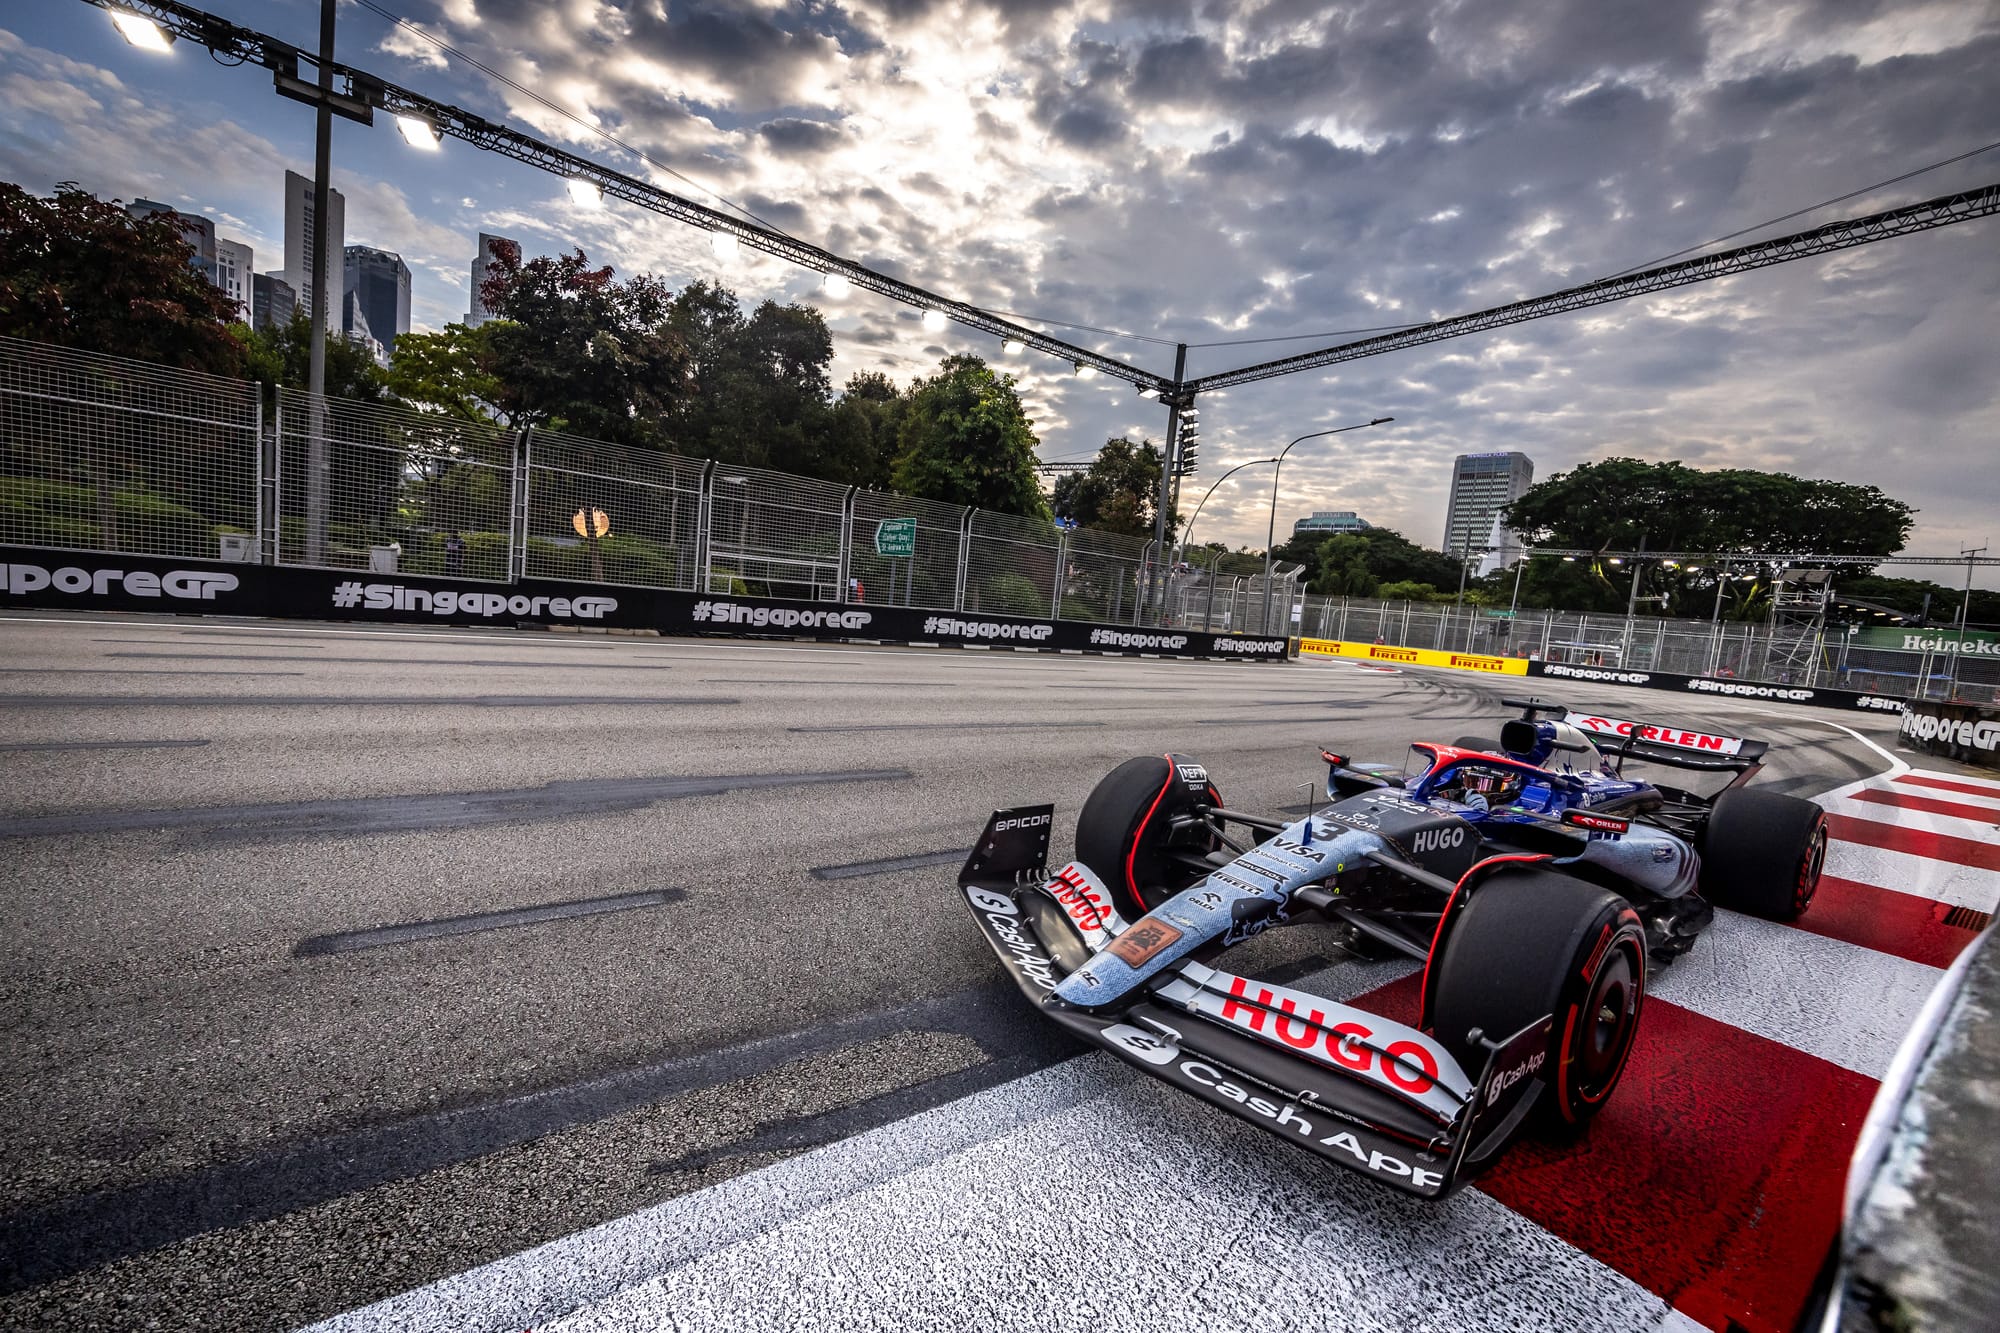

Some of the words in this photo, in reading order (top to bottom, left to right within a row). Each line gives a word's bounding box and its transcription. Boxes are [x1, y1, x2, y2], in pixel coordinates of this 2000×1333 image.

[0, 563, 239, 600] poreGP
[332, 581, 618, 619] #SingaporeGP
[692, 601, 872, 630] #SingaporeGP
[924, 616, 1053, 640] #SingaporeGP
[1090, 628, 1188, 649] #SingaporeGP
[1213, 637, 1285, 653] #SingaporeGP
[1370, 647, 1418, 662] PIRELLI
[1450, 655, 1504, 671] PIRELLI
[1544, 664, 1650, 684] #SingaporeGP
[1687, 678, 1814, 701] #SingaporeGP
[1616, 722, 1723, 750] ORLEN
[994, 814, 1050, 832] EPICOR
[1312, 822, 1350, 842] 3
[1326, 811, 1380, 831] TUDOR
[1596, 820, 1622, 829] ORLEN
[1273, 837, 1327, 863] VISA
[1413, 827, 1464, 854] HUGO
[1237, 860, 1281, 881] RAVENOL
[1260, 851, 1288, 865] Shinhan
[1288, 862, 1308, 873] Card
[1212, 871, 1265, 896] PIRELLI
[1048, 865, 1112, 931] HUGO
[1188, 896, 1215, 912] ORLEN
[986, 913, 1037, 952] Cash
[1222, 976, 1439, 1095] HUGO
[1502, 1061, 1527, 1090] Cash
[1527, 1050, 1545, 1074] App
[1179, 1060, 1313, 1137] Cash
